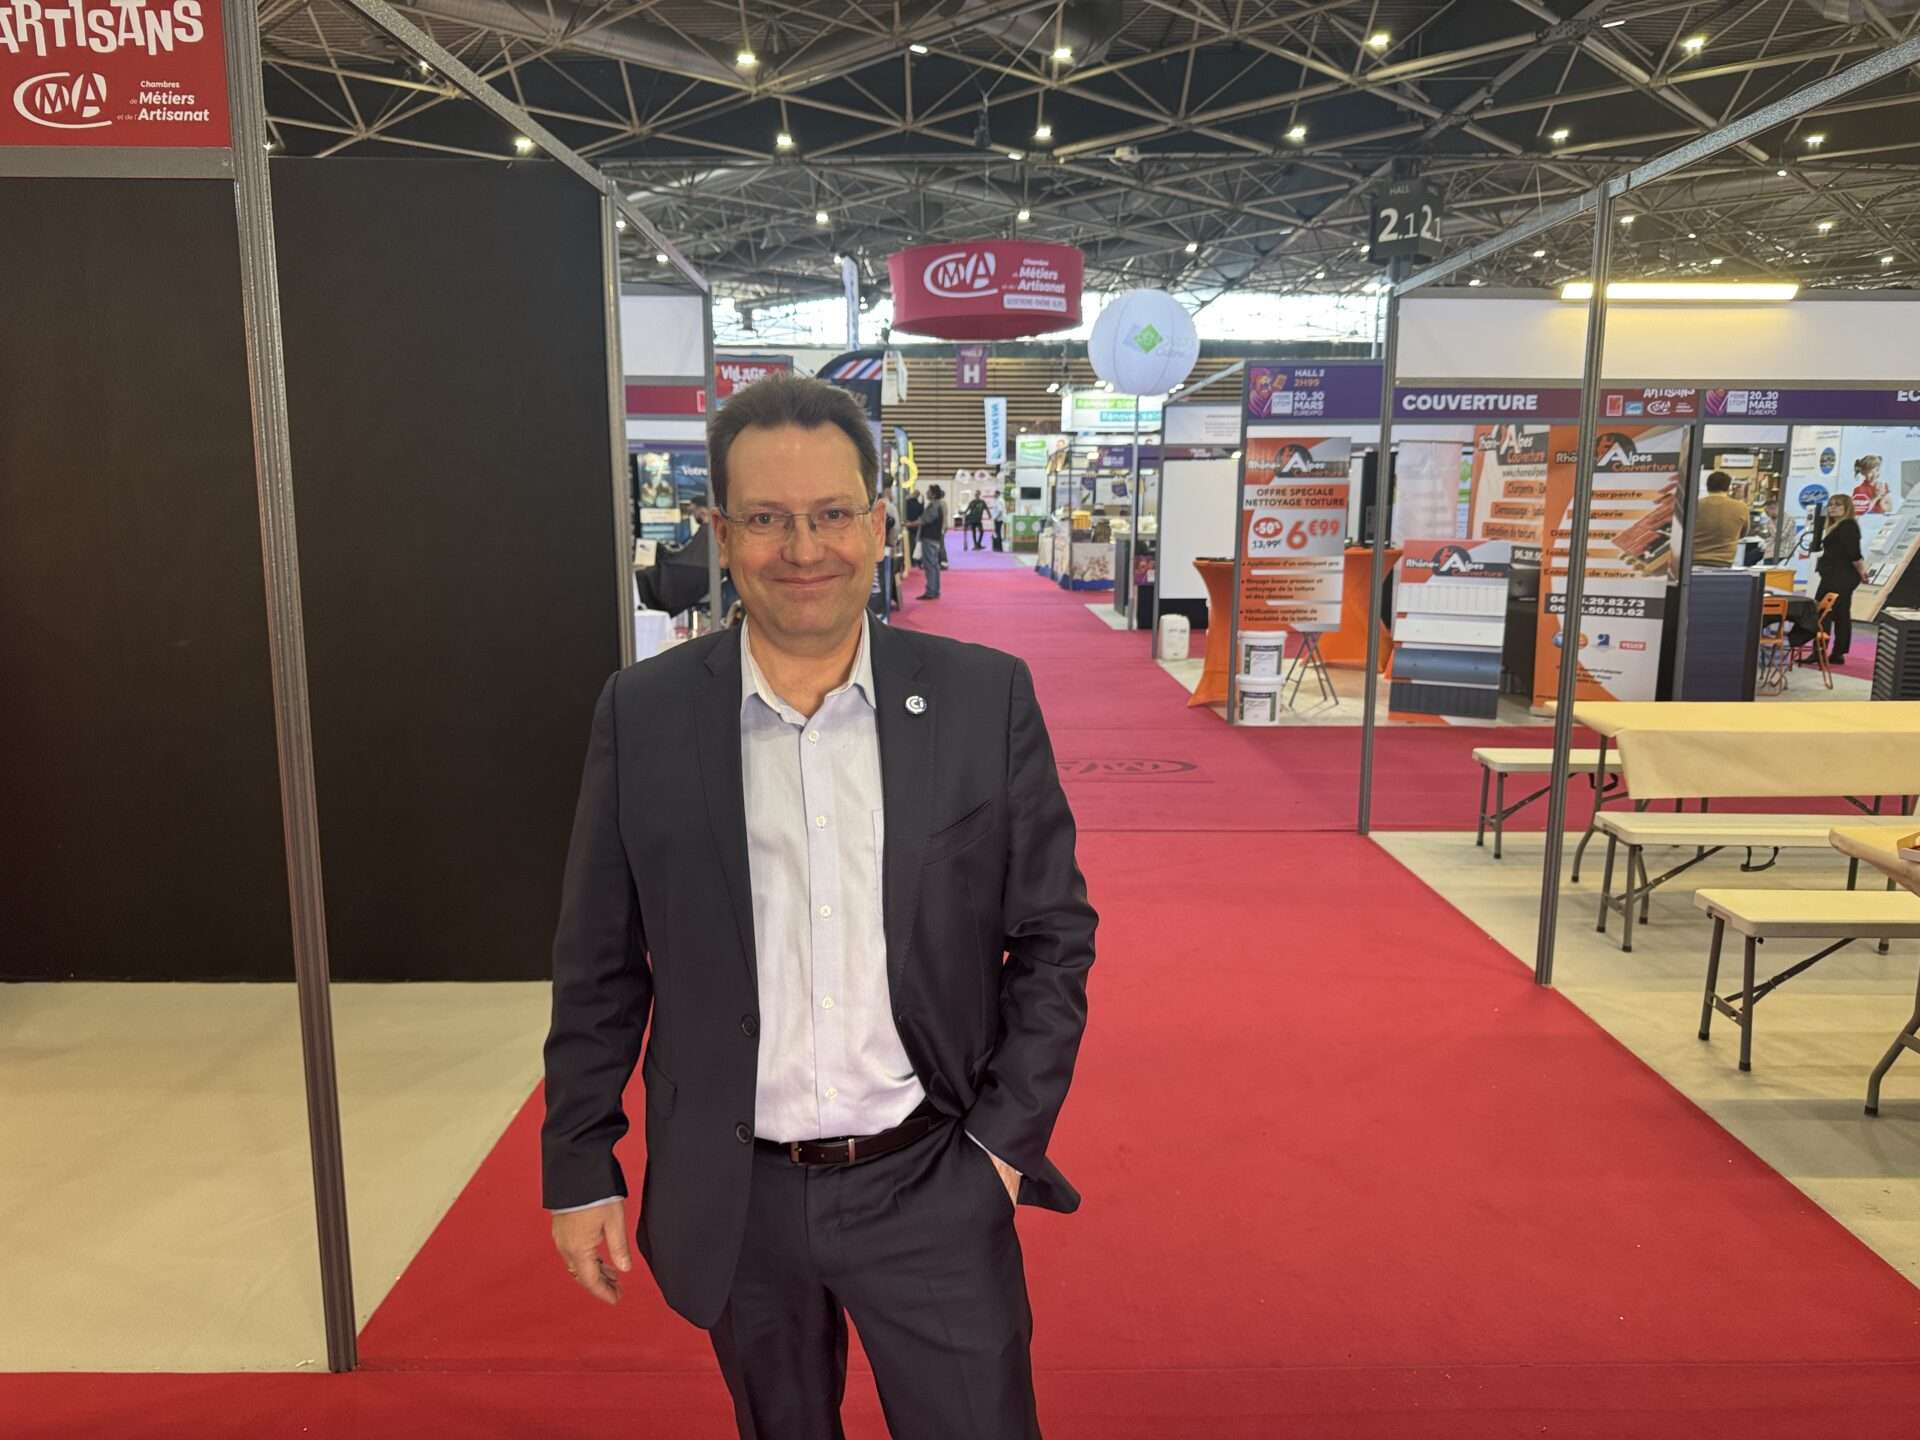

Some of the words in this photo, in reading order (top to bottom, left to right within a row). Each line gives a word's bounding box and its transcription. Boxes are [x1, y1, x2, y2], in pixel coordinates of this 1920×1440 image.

[140, 80, 180, 89] Chambres
[13, 72, 112, 129] CMA
[139, 91, 195, 105] Métiers
[923, 252, 999, 298] CMA
[963, 363, 980, 384] H
[1402, 394, 1538, 411] COUVERTURE
[1748, 401, 1778, 409] MARS
[1256, 488, 1286, 496] OFFRE
[1246, 498, 1301, 506] NETTOYAGE
[1305, 498, 1344, 506] TOITURE
